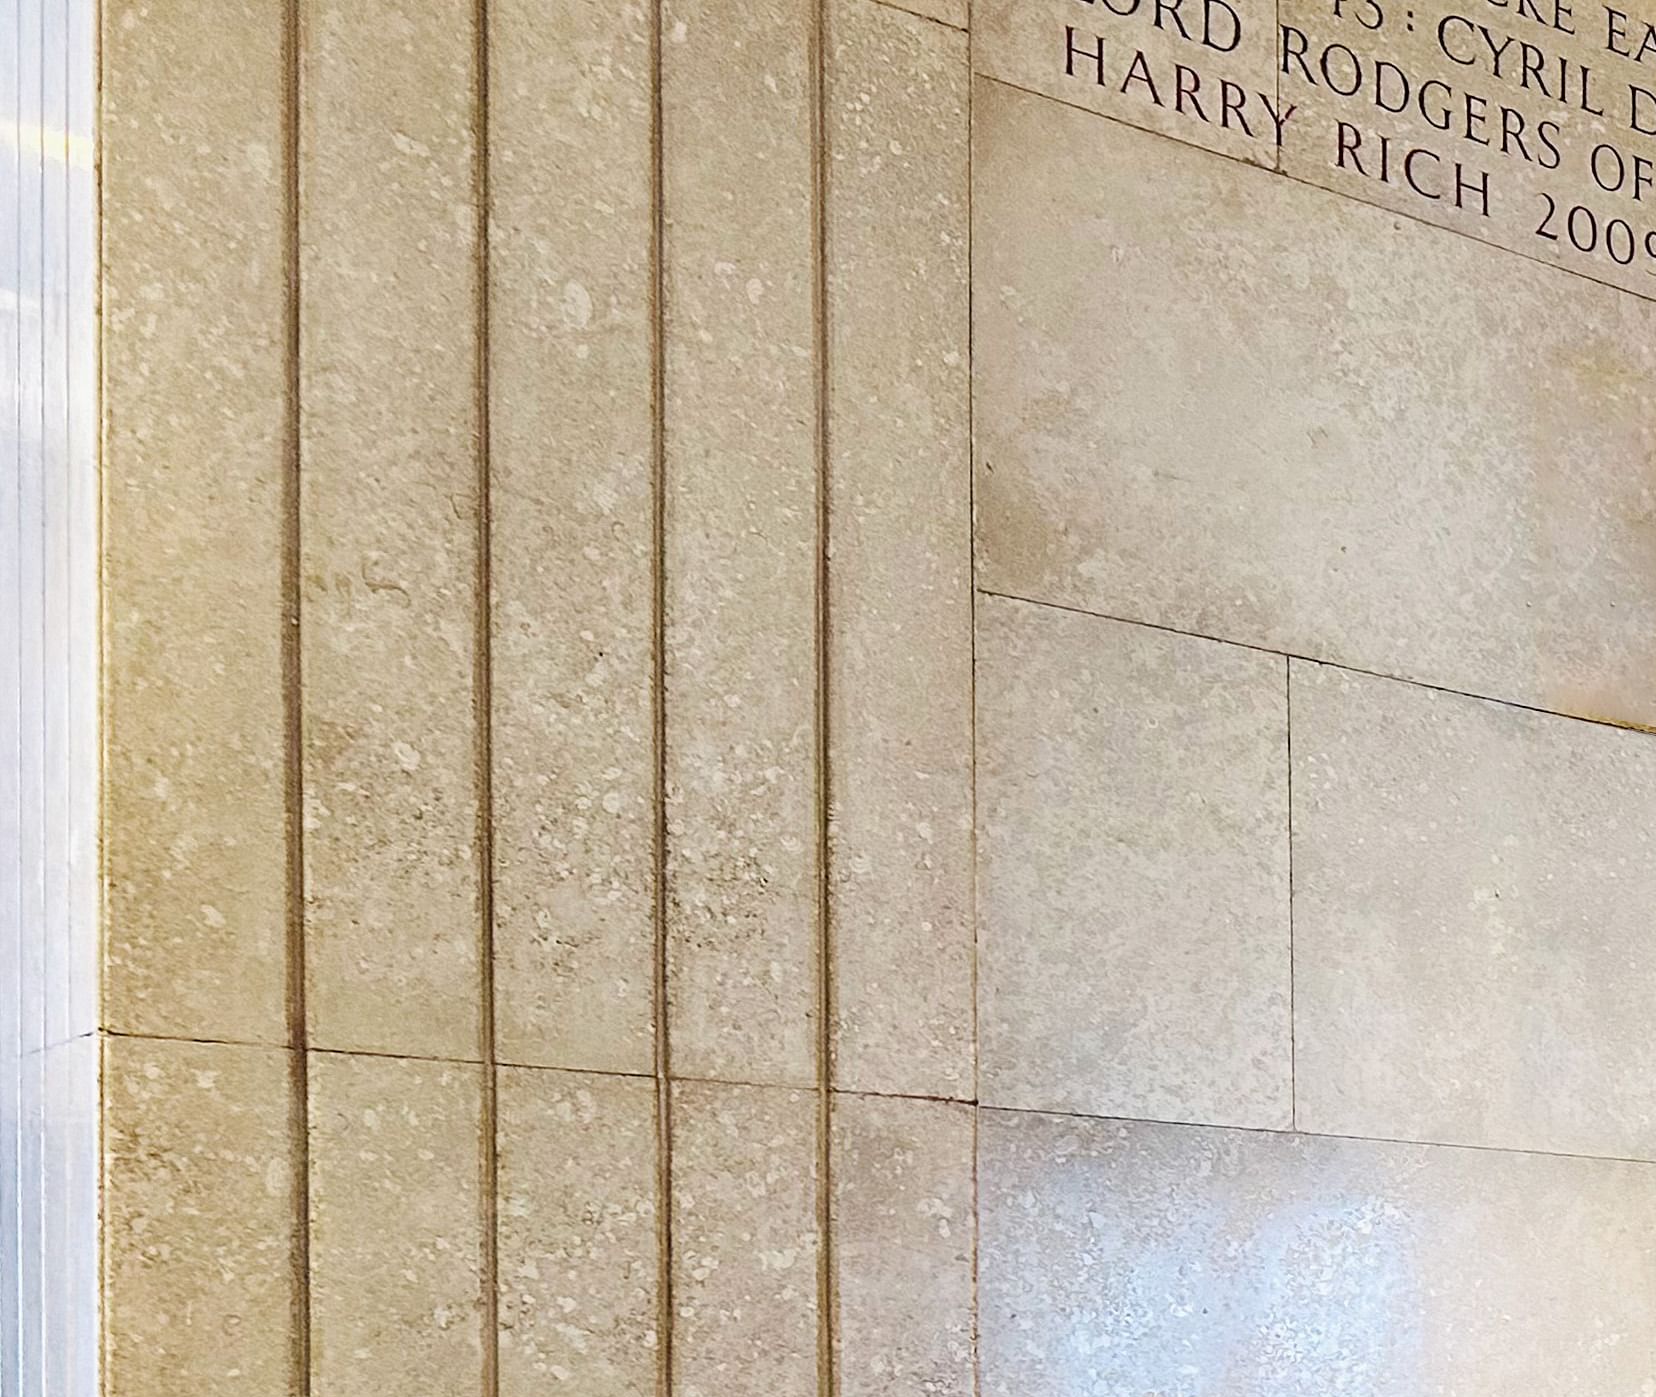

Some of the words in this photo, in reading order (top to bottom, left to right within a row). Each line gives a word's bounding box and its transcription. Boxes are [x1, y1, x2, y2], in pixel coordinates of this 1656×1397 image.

[1064, 25, 1298, 147] HARRY
[1335, 121, 1490, 217] RICH
[1278, 24, 1561, 170] RODGERS
[1590, 143, 1654, 201] OF
[1437, 15, 1604, 117] CYRIL
